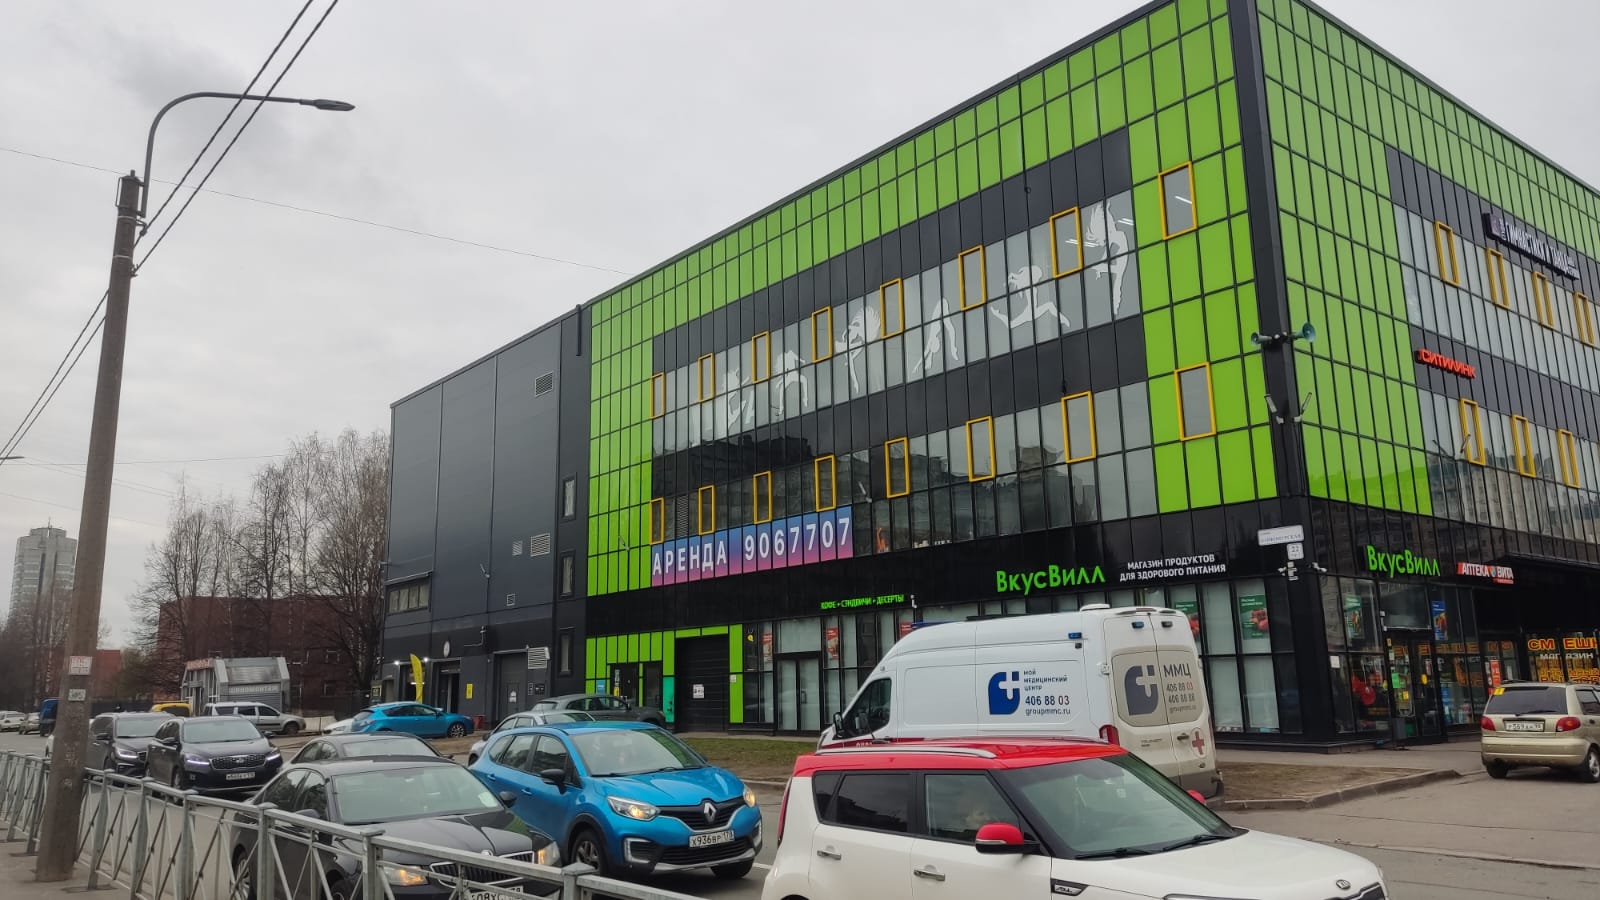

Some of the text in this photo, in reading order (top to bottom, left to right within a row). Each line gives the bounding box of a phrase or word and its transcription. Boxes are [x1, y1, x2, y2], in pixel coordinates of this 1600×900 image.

[1419, 348, 1476, 378] СИТИЛИНК
[652, 517, 850, 575] АРЕНДА 9067707
[1127, 554, 1215, 570] МАГАЗИН ПРОДУКТОВ
[1120, 564, 1226, 582] ДЛЯ ЗДОРОВОГО ПИТАНИЯ
[1462, 562, 1514, 579] АПТЕКА ВИТА
[877, 594, 904, 605] ДЕСЕРТЫ
[1163, 663, 1191, 678] ММЦ
[1025, 695, 1070, 705] 406 88 03
